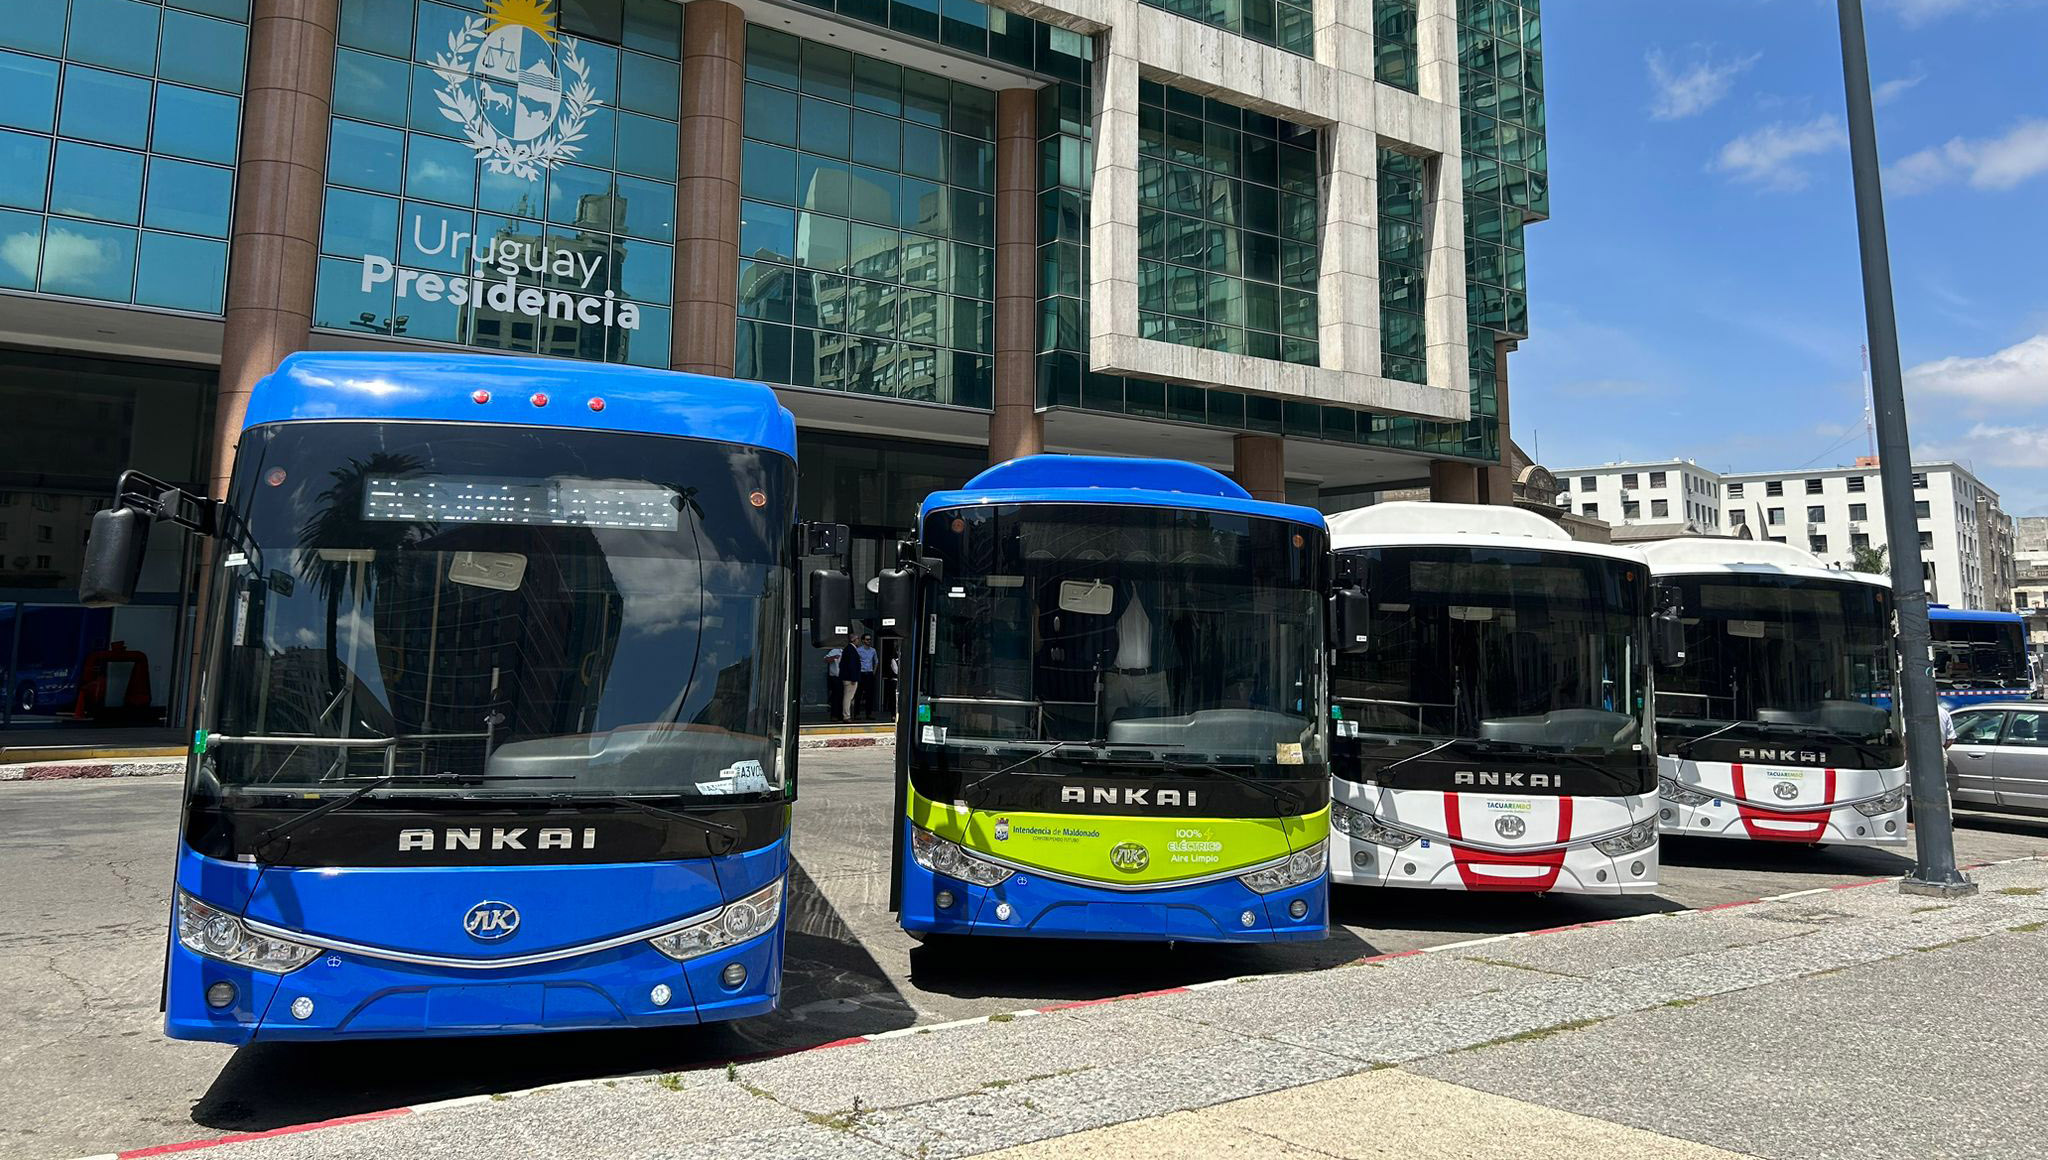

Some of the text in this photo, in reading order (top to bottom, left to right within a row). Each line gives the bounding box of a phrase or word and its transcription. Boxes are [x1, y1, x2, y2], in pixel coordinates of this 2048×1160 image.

[414, 215, 603, 289] Uruguay
[361, 253, 640, 330] Presidencia
[1739, 748, 1826, 763] ANKAI
[1454, 771, 1561, 788] ANKAI
[1061, 786, 1197, 807] ANKAI
[399, 827, 596, 851] ANKAI
[1013, 826, 1051, 835] Intendencia
[1062, 828, 1100, 838] Maldonado
[1176, 829, 1203, 838] 100%
[1191, 854, 1220, 864] Limpio
